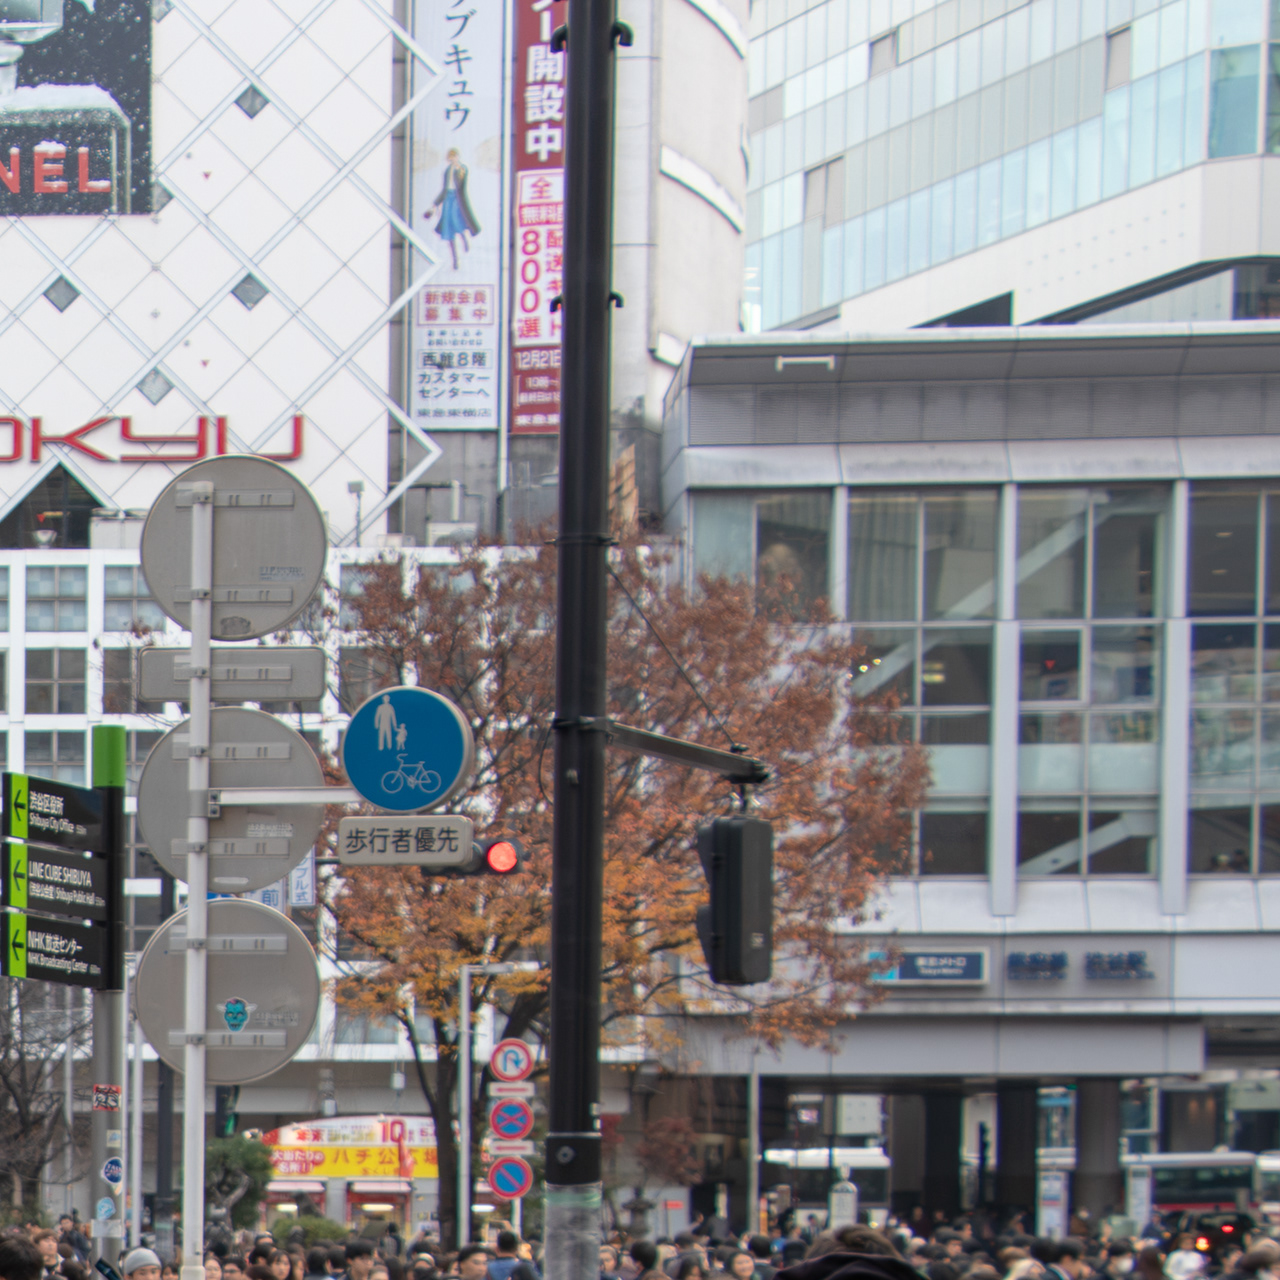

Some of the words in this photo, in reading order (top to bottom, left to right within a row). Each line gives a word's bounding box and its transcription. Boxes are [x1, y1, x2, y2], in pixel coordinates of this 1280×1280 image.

[418, 372, 490, 385] カスタマー
[418, 387, 490, 399] センターへ
[345, 826, 460, 855] 歩行者優先
[28, 860, 44, 880] LINE
[44, 863, 62, 882] CUBE
[63, 866, 93, 888] SHIBUYA
